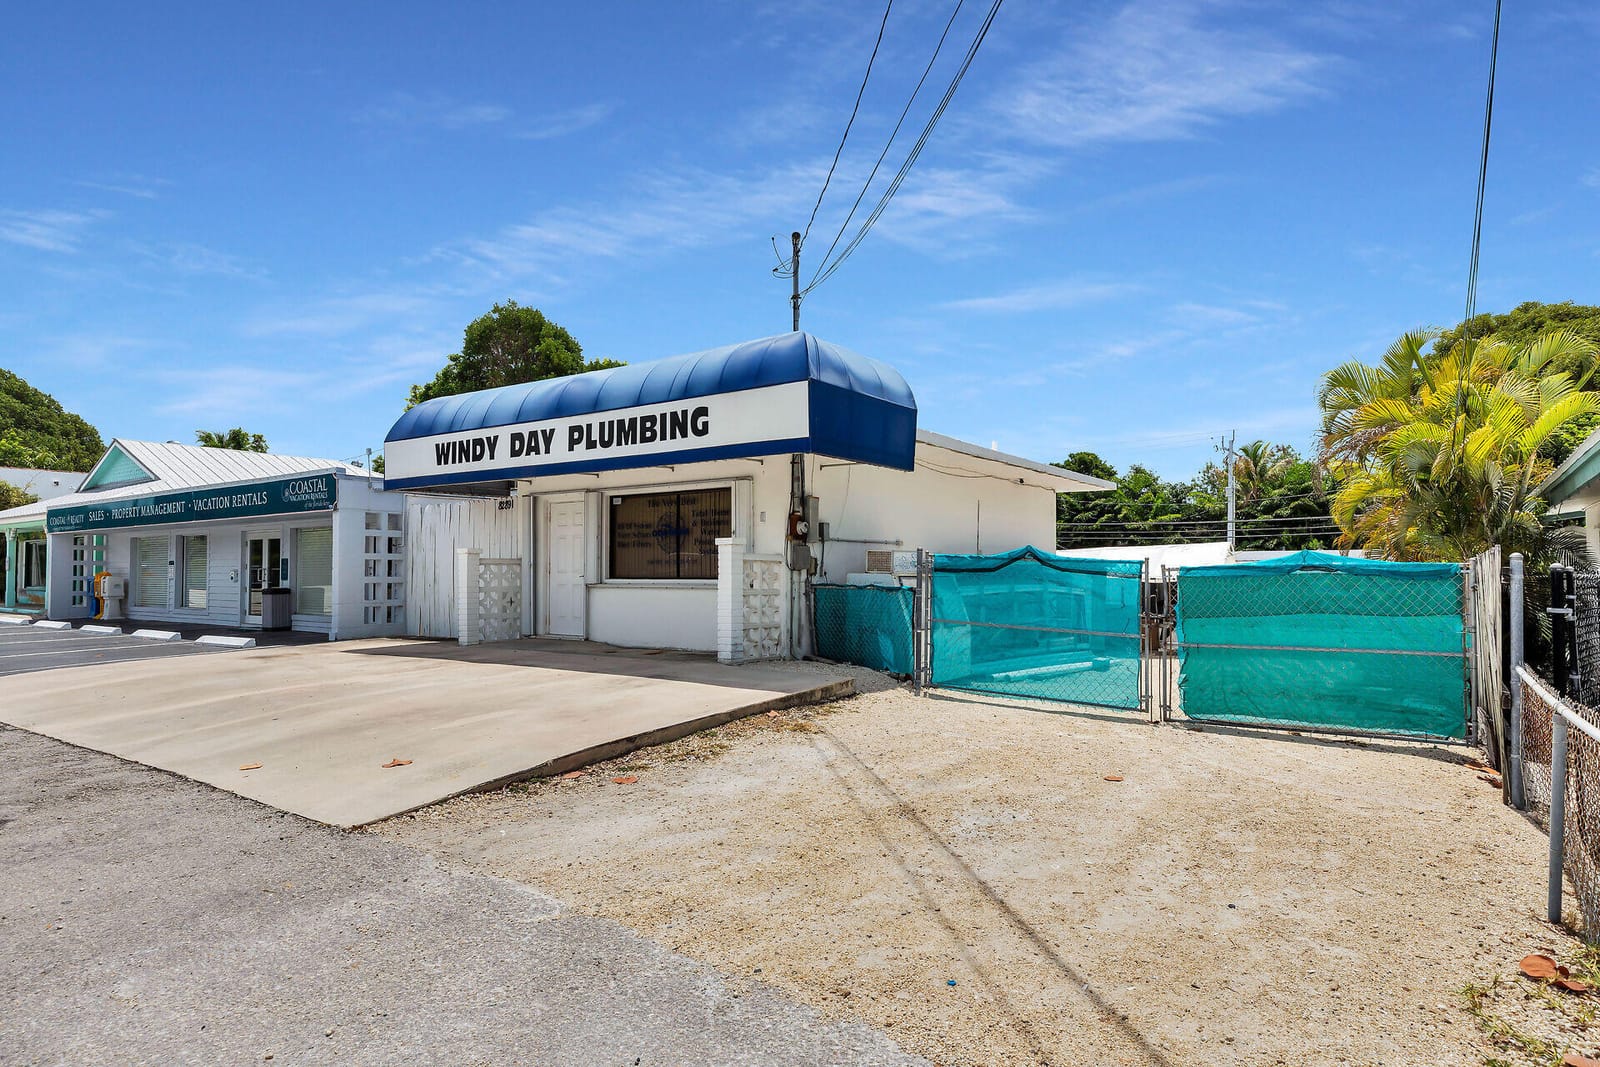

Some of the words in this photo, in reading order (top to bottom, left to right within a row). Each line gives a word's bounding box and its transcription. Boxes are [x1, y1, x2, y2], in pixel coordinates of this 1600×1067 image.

[435, 435, 499, 466] WINDY
[509, 428, 556, 458] DAY
[568, 406, 709, 452] PLUMBING
[289, 478, 328, 494] COASTAL
[289, 493, 310, 502] VACATION
[89, 510, 105, 522] SALES
[111, 506, 140, 520] PROPERTY
[140, 501, 185, 516] MANAGEMENT
[192, 496, 230, 511] VACATION
[232, 491, 268, 507] RENTALS
[49, 516, 66, 526] COASTAL
[70, 514, 84, 525] REALTY
